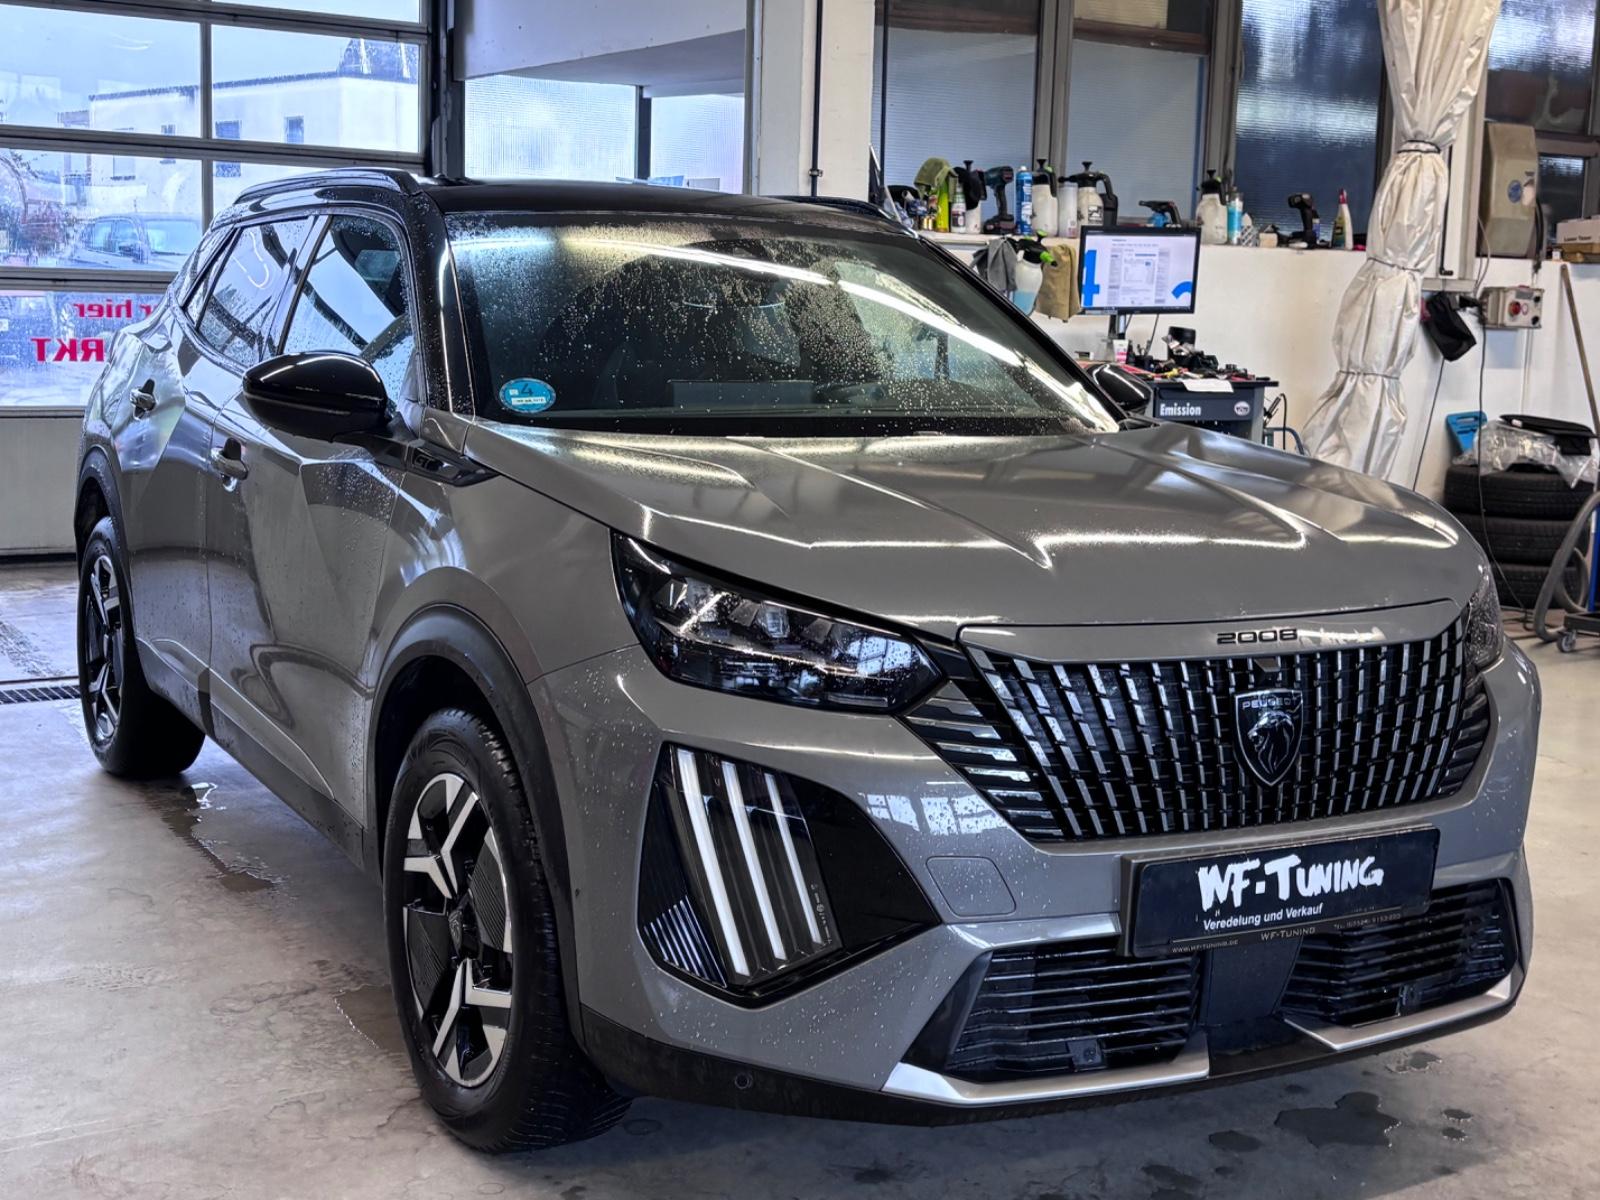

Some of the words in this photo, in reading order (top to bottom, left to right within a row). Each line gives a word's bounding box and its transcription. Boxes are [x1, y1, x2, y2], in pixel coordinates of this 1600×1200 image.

[1160, 403, 1202, 416] Emission
[1217, 629, 1298, 644] 2008
[1203, 911, 1261, 931] Veredelung
[1263, 908, 1283, 923] und
[1285, 902, 1324, 919] Verkauf
